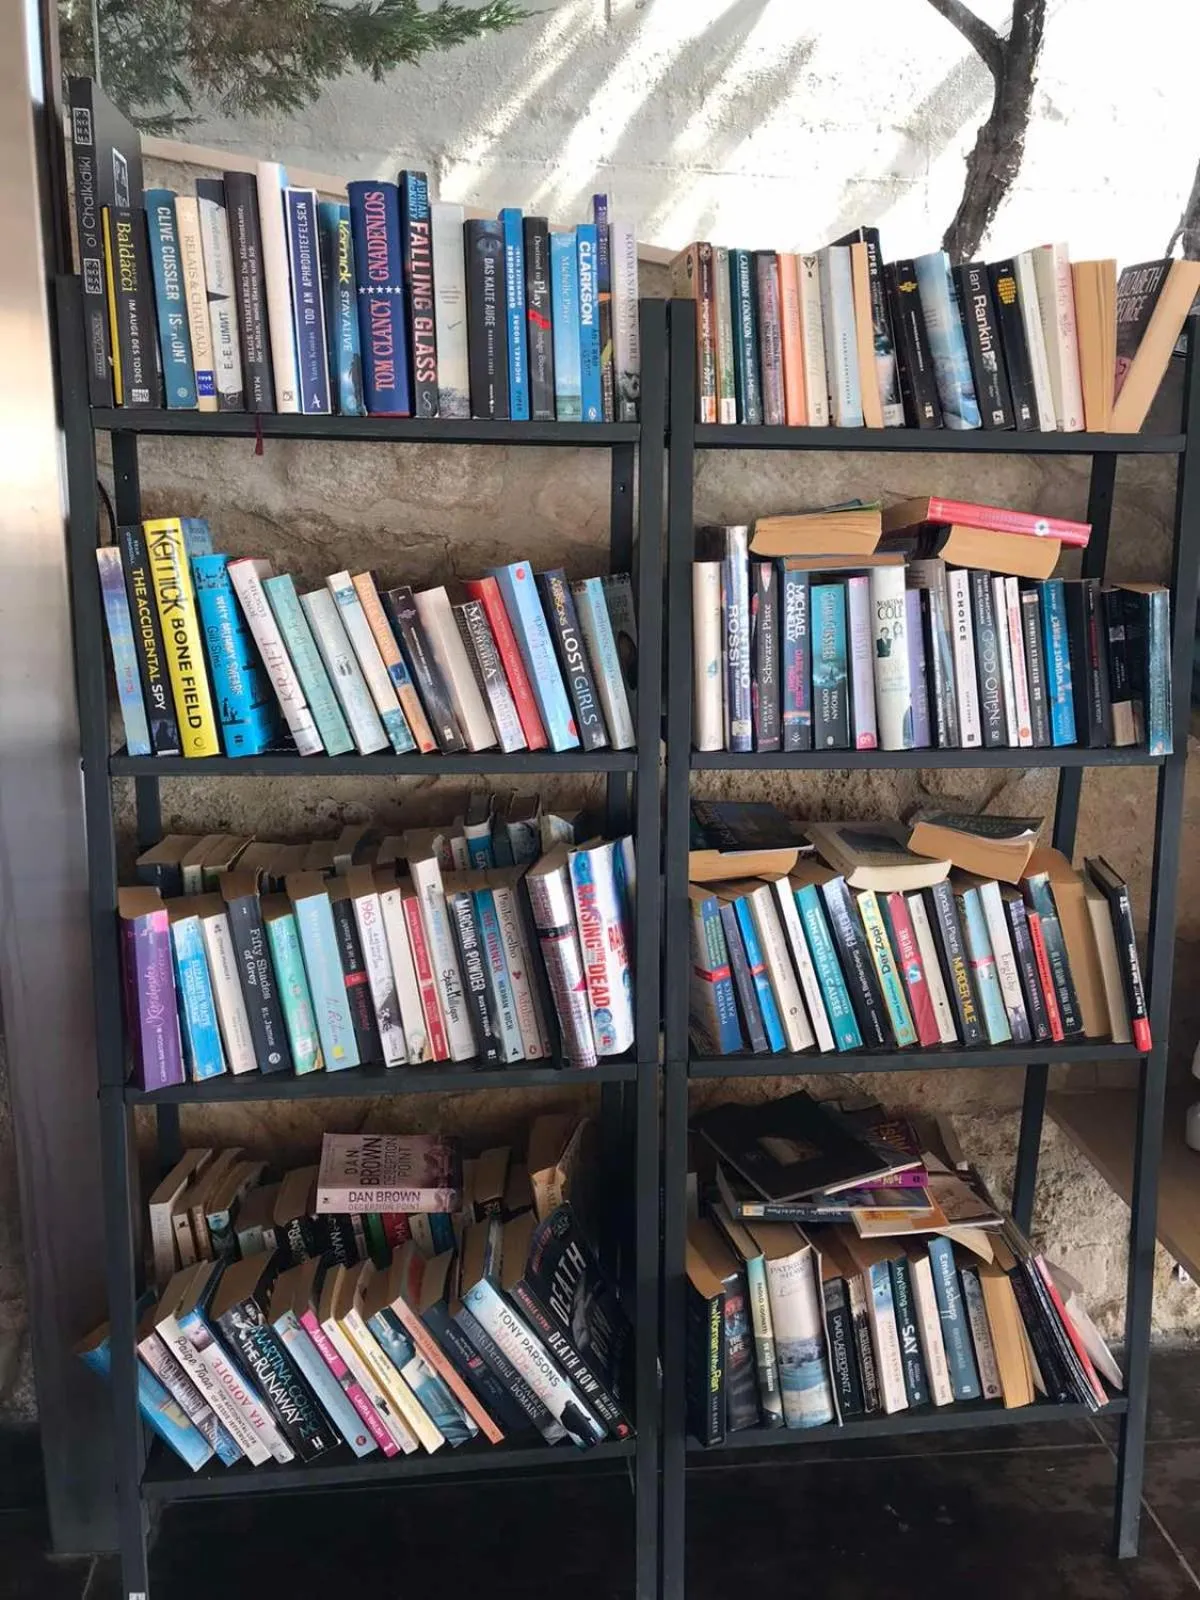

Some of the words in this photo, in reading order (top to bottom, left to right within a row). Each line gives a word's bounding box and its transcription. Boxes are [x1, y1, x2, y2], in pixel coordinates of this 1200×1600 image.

[79, 156, 96, 230] Chalkidiki
[416, 179, 427, 219] ADRIAN
[157, 207, 174, 242] CLIVE
[363, 192, 390, 281] GNADENLOS
[116, 223, 137, 292] Baldacci
[296, 202, 312, 287] APHRODITEFELSEN
[533, 235, 543, 270] Destined
[868, 243, 877, 276] PIPER
[161, 246, 178, 300] CUSSLER
[240, 260, 248, 274] Die
[410, 221, 432, 310] FALLING
[484, 257, 494, 276] DAS
[561, 255, 570, 296] Michelle
[740, 255, 749, 298] CATHERINE
[968, 269, 982, 291] Ian
[484, 276, 495, 302] KALTE
[530, 280, 546, 308] Play
[580, 241, 593, 325] CLARKSON
[127, 299, 138, 310] IM
[242, 275, 254, 332] TIMMERBERG
[304, 308, 315, 325] TOD
[340, 290, 351, 318] STAY
[485, 304, 496, 327] AUGE
[742, 299, 753, 338] COOKSON
[128, 312, 137, 336] AUGE
[219, 311, 231, 344] ШМИТ
[342, 320, 352, 352] ALIVE
[372, 299, 393, 356] CLANCY
[973, 294, 993, 352] Rankin
[131, 338, 140, 355] DES
[247, 334, 256, 362] HELGE
[415, 317, 435, 383] GLASS
[133, 357, 143, 384] TODES
[380, 359, 395, 392] TOM
[514, 346, 522, 383] MICHAEL
[132, 567, 147, 597] THE
[149, 529, 188, 615] Kernick
[982, 575, 991, 592] TERRY
[216, 595, 228, 619] WHY
[762, 604, 772, 631] Piste
[786, 582, 796, 643] CONNELLY
[795, 584, 806, 640] MICHAEL
[877, 606, 904, 620] COLE
[956, 591, 967, 641] CHOICE
[983, 593, 993, 626] PRATCHETT
[136, 598, 160, 683] ACCIDENTAL
[171, 617, 193, 672] BONE
[206, 626, 220, 643] Gill
[220, 622, 235, 660] MUMMY
[728, 605, 741, 667] ROSSI
[982, 629, 994, 673] GOOD
[210, 644, 222, 669] Sims
[260, 637, 297, 702] KRAFT
[762, 632, 774, 685] Schwarze
[561, 628, 585, 674] LOST
[573, 676, 598, 726] GIRLS
[152, 684, 166, 711] SPY
[181, 676, 203, 729] FIELD
[821, 688, 831, 722] ODYSSEY
[830, 690, 838, 721] TROJAN
[361, 899, 375, 927] 1963
[498, 893, 513, 922] Paulo
[577, 883, 602, 949] RAISING
[937, 887, 953, 913] Lynda
[455, 898, 475, 949] MARCHING
[837, 913, 858, 946] FALKEN
[944, 914, 954, 925] La
[486, 931, 504, 973] DINNER
[504, 922, 520, 959] Coelho
[869, 925, 886, 950] Zopf
[947, 926, 960, 954] Plante
[243, 950, 252, 960] of
[249, 927, 264, 956] Fifty
[257, 959, 272, 1000] Shades
[464, 952, 486, 992] POWDER
[597, 948, 606, 963] THE
[805, 909, 832, 978] UNNATURAL
[825, 979, 844, 1018] CAUSES
[880, 953, 891, 975] Der
[246, 961, 258, 986] Grey
[441, 969, 456, 991] Spike
[588, 964, 611, 1007] DEAD
[951, 957, 971, 998] MURDER
[446, 990, 462, 1024] Milligan
[478, 995, 487, 1015] RUSTY
[518, 990, 535, 1035] Adultery
[716, 983, 728, 1025] PHAEDRA
[963, 999, 977, 1024] MILE
[263, 1019, 275, 1046] James
[481, 1016, 492, 1038] YOUNG
[344, 1150, 360, 1175] DAN
[360, 1137, 382, 1186] BROWN
[398, 1147, 412, 1178] POINT
[348, 1191, 373, 1203] DAN
[376, 1191, 421, 1203] BROWN
[348, 1203, 395, 1211] DECEPTION
[548, 1240, 587, 1328] DEATH
[895, 1265, 909, 1307] Anything
[939, 1253, 952, 1286] Emelie
[711, 1300, 719, 1312] The
[756, 1282, 765, 1303] PAOLO
[941, 1287, 961, 1320] Schepp
[710, 1312, 723, 1355] Woman
[759, 1304, 769, 1335] COGNETTI
[832, 1314, 844, 1340] DAVID
[250, 1325, 290, 1387] MARTINA
[496, 1307, 523, 1341] TONY
[520, 1336, 561, 1388] PARSONS
[517, 1288, 539, 1320] MICHELLE
[547, 1331, 582, 1369] DEATH
[575, 1367, 600, 1394] ROW
[858, 1326, 870, 1357] MICHAEL
[901, 1324, 918, 1355] SAY
[174, 1336, 196, 1366] Paige
[197, 1363, 212, 1390] Toon
[711, 1354, 719, 1371] Who
[834, 1339, 851, 1395] LAGERCRANTZ
[862, 1357, 875, 1391] CRICHTON
[213, 1358, 249, 1406] ДОРОГЕ
[241, 1340, 256, 1363] THE
[253, 1358, 306, 1425] RUNAWAY
[710, 1370, 723, 1392] Ran
[354, 1395, 368, 1416] LAURA
[366, 1414, 384, 1438] WALSH
[509, 1382, 539, 1419] DOMAIN
[226, 1401, 248, 1432] ACCIDENTAL
[248, 1431, 257, 1444] LIFE
[250, 1408, 265, 1429] НА
